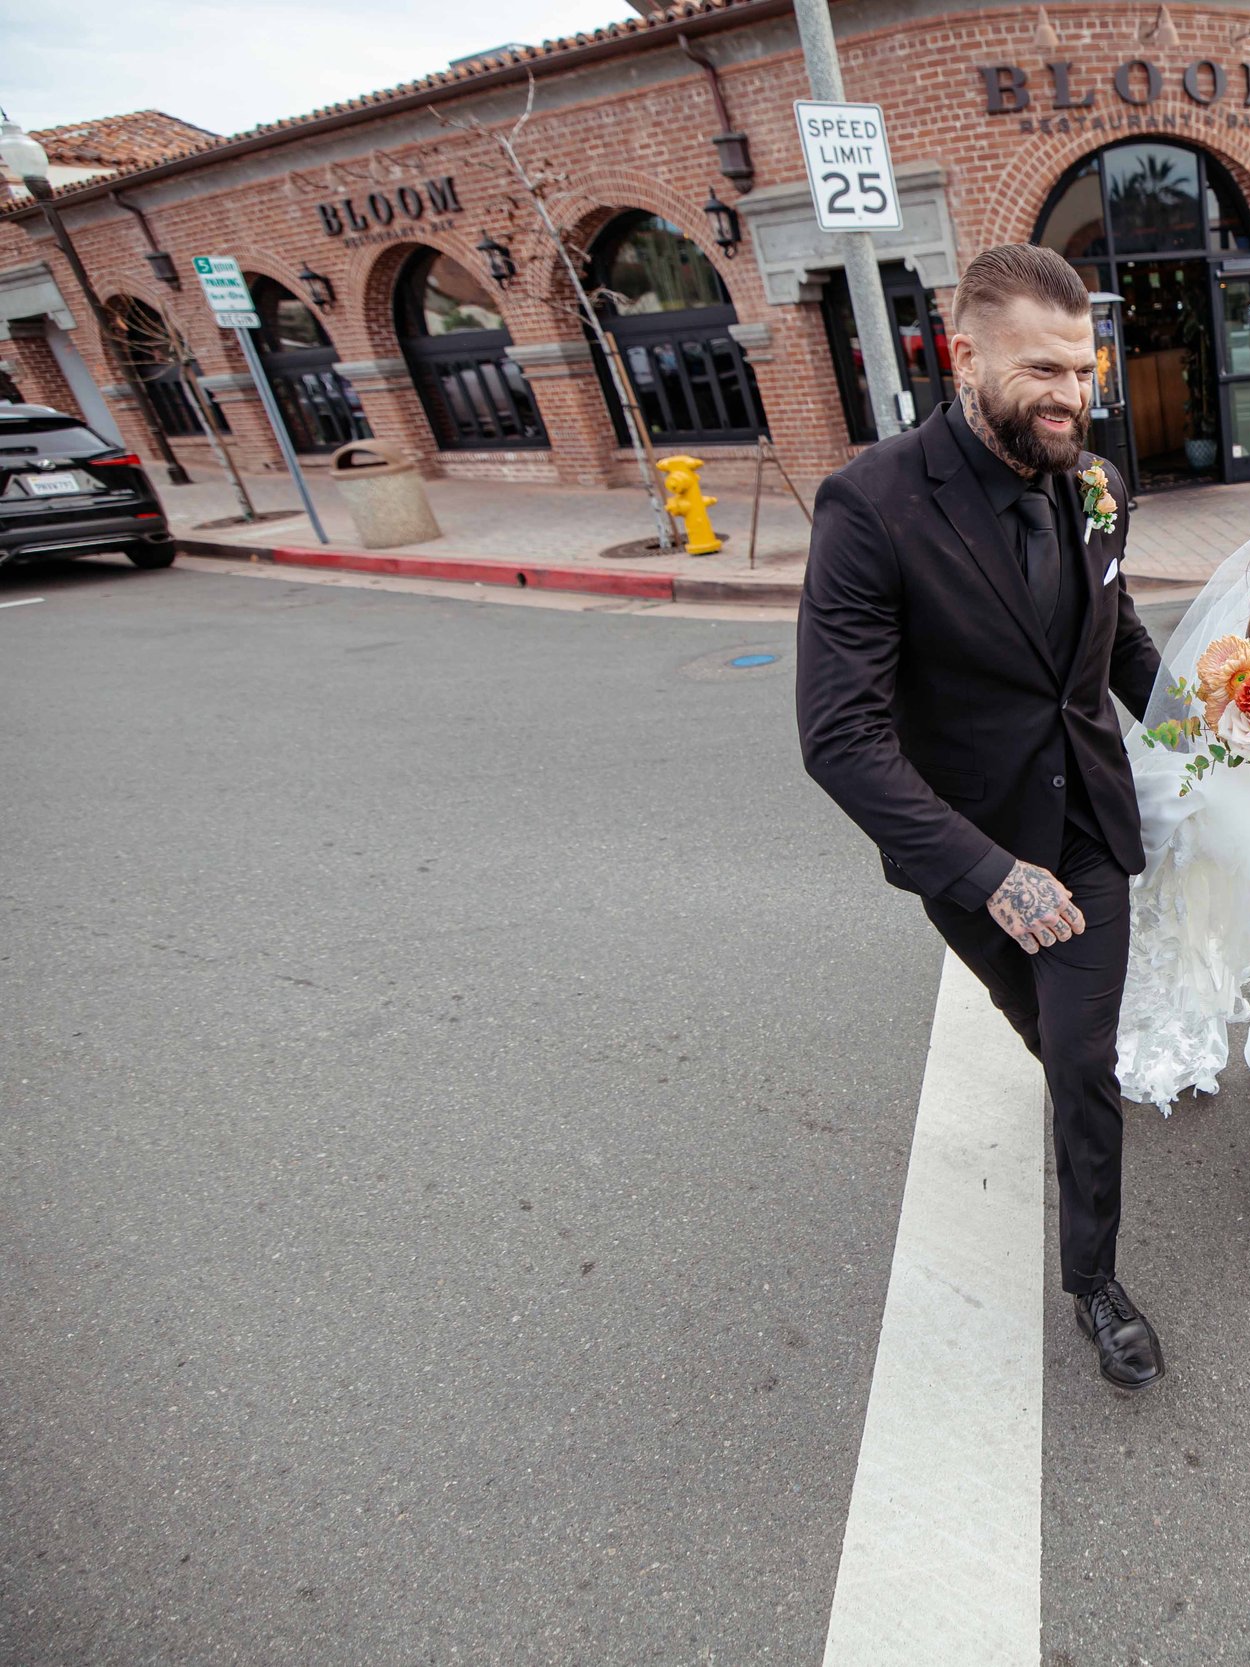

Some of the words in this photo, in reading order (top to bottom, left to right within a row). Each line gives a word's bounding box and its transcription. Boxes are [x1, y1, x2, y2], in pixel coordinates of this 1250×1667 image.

[808, 118, 878, 139] SPEED
[1019, 113, 1191, 134] RESTAURANT
[820, 145, 873, 165] LIMIT
[821, 171, 888, 214] 25
[317, 176, 464, 237] BLOOM
[197, 260, 210, 272] 5
